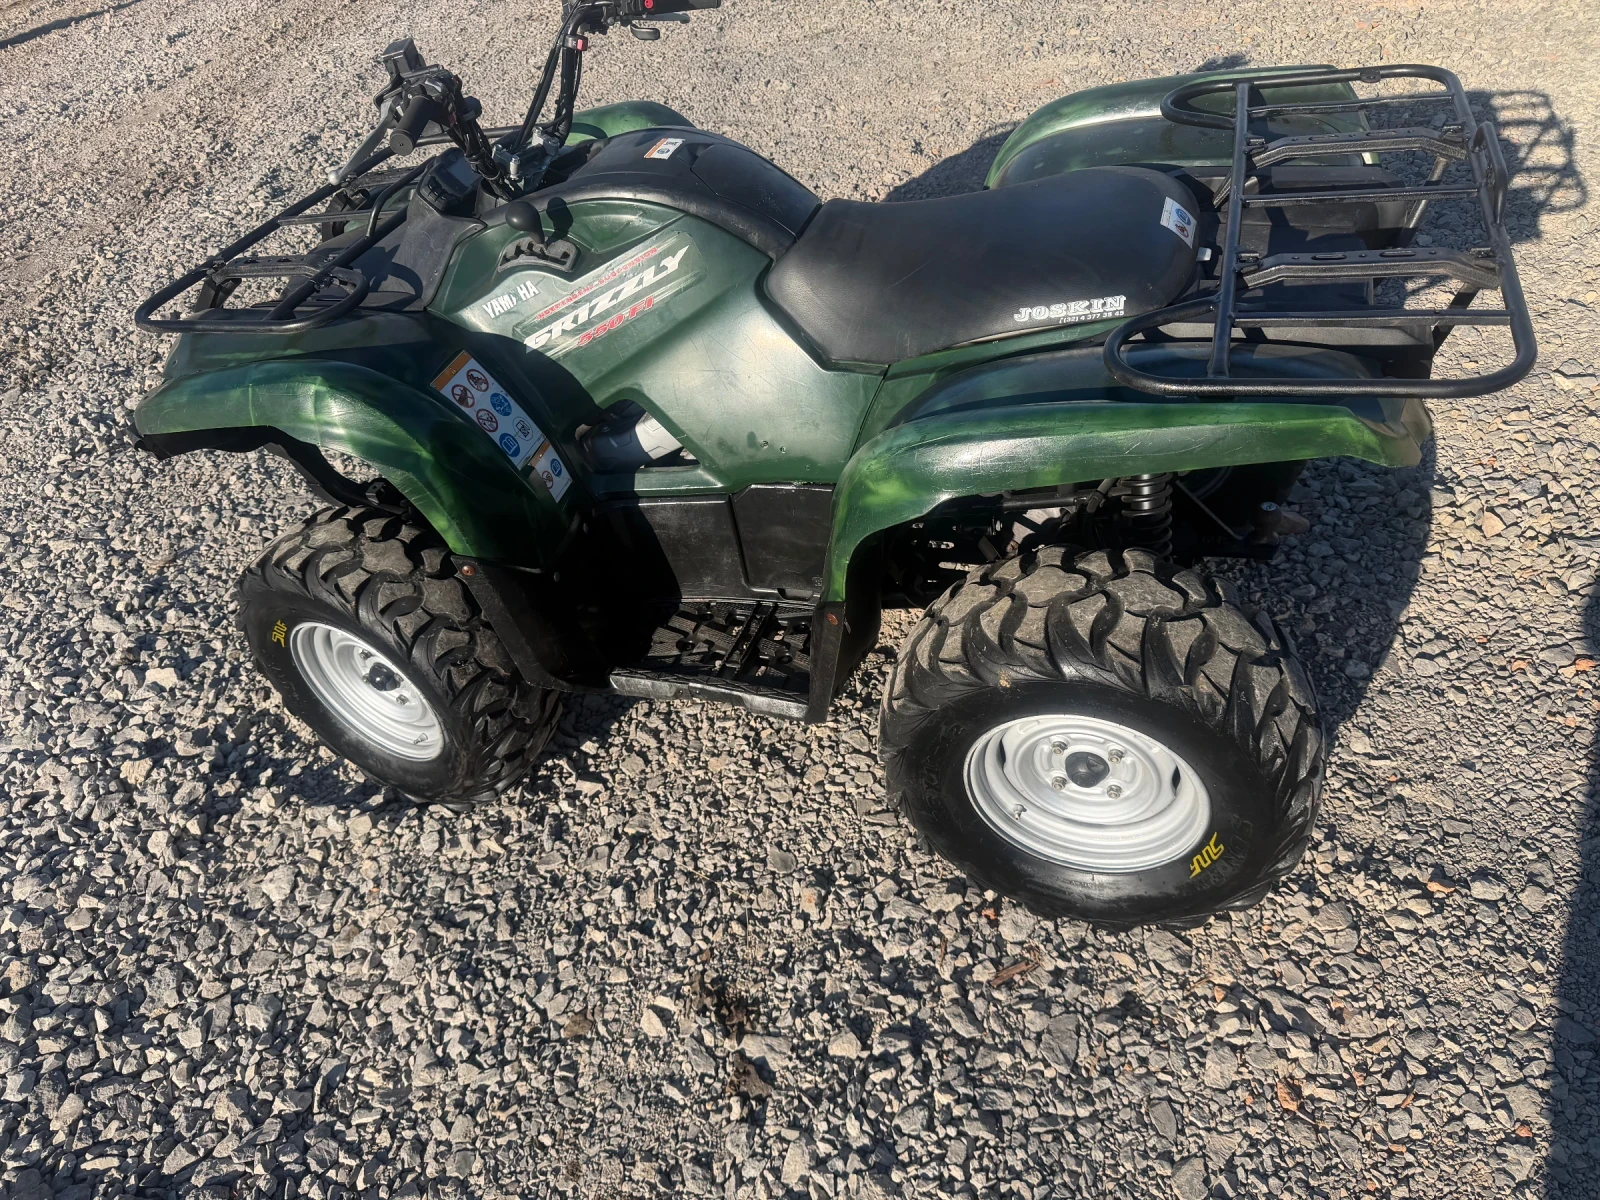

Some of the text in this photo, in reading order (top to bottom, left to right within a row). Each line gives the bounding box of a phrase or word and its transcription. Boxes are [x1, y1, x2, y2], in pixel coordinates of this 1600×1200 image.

[523, 244, 690, 354] GRIZZLY
[577, 296, 655, 347] 550 FI
[1013, 294, 1127, 322] JOSKIN
